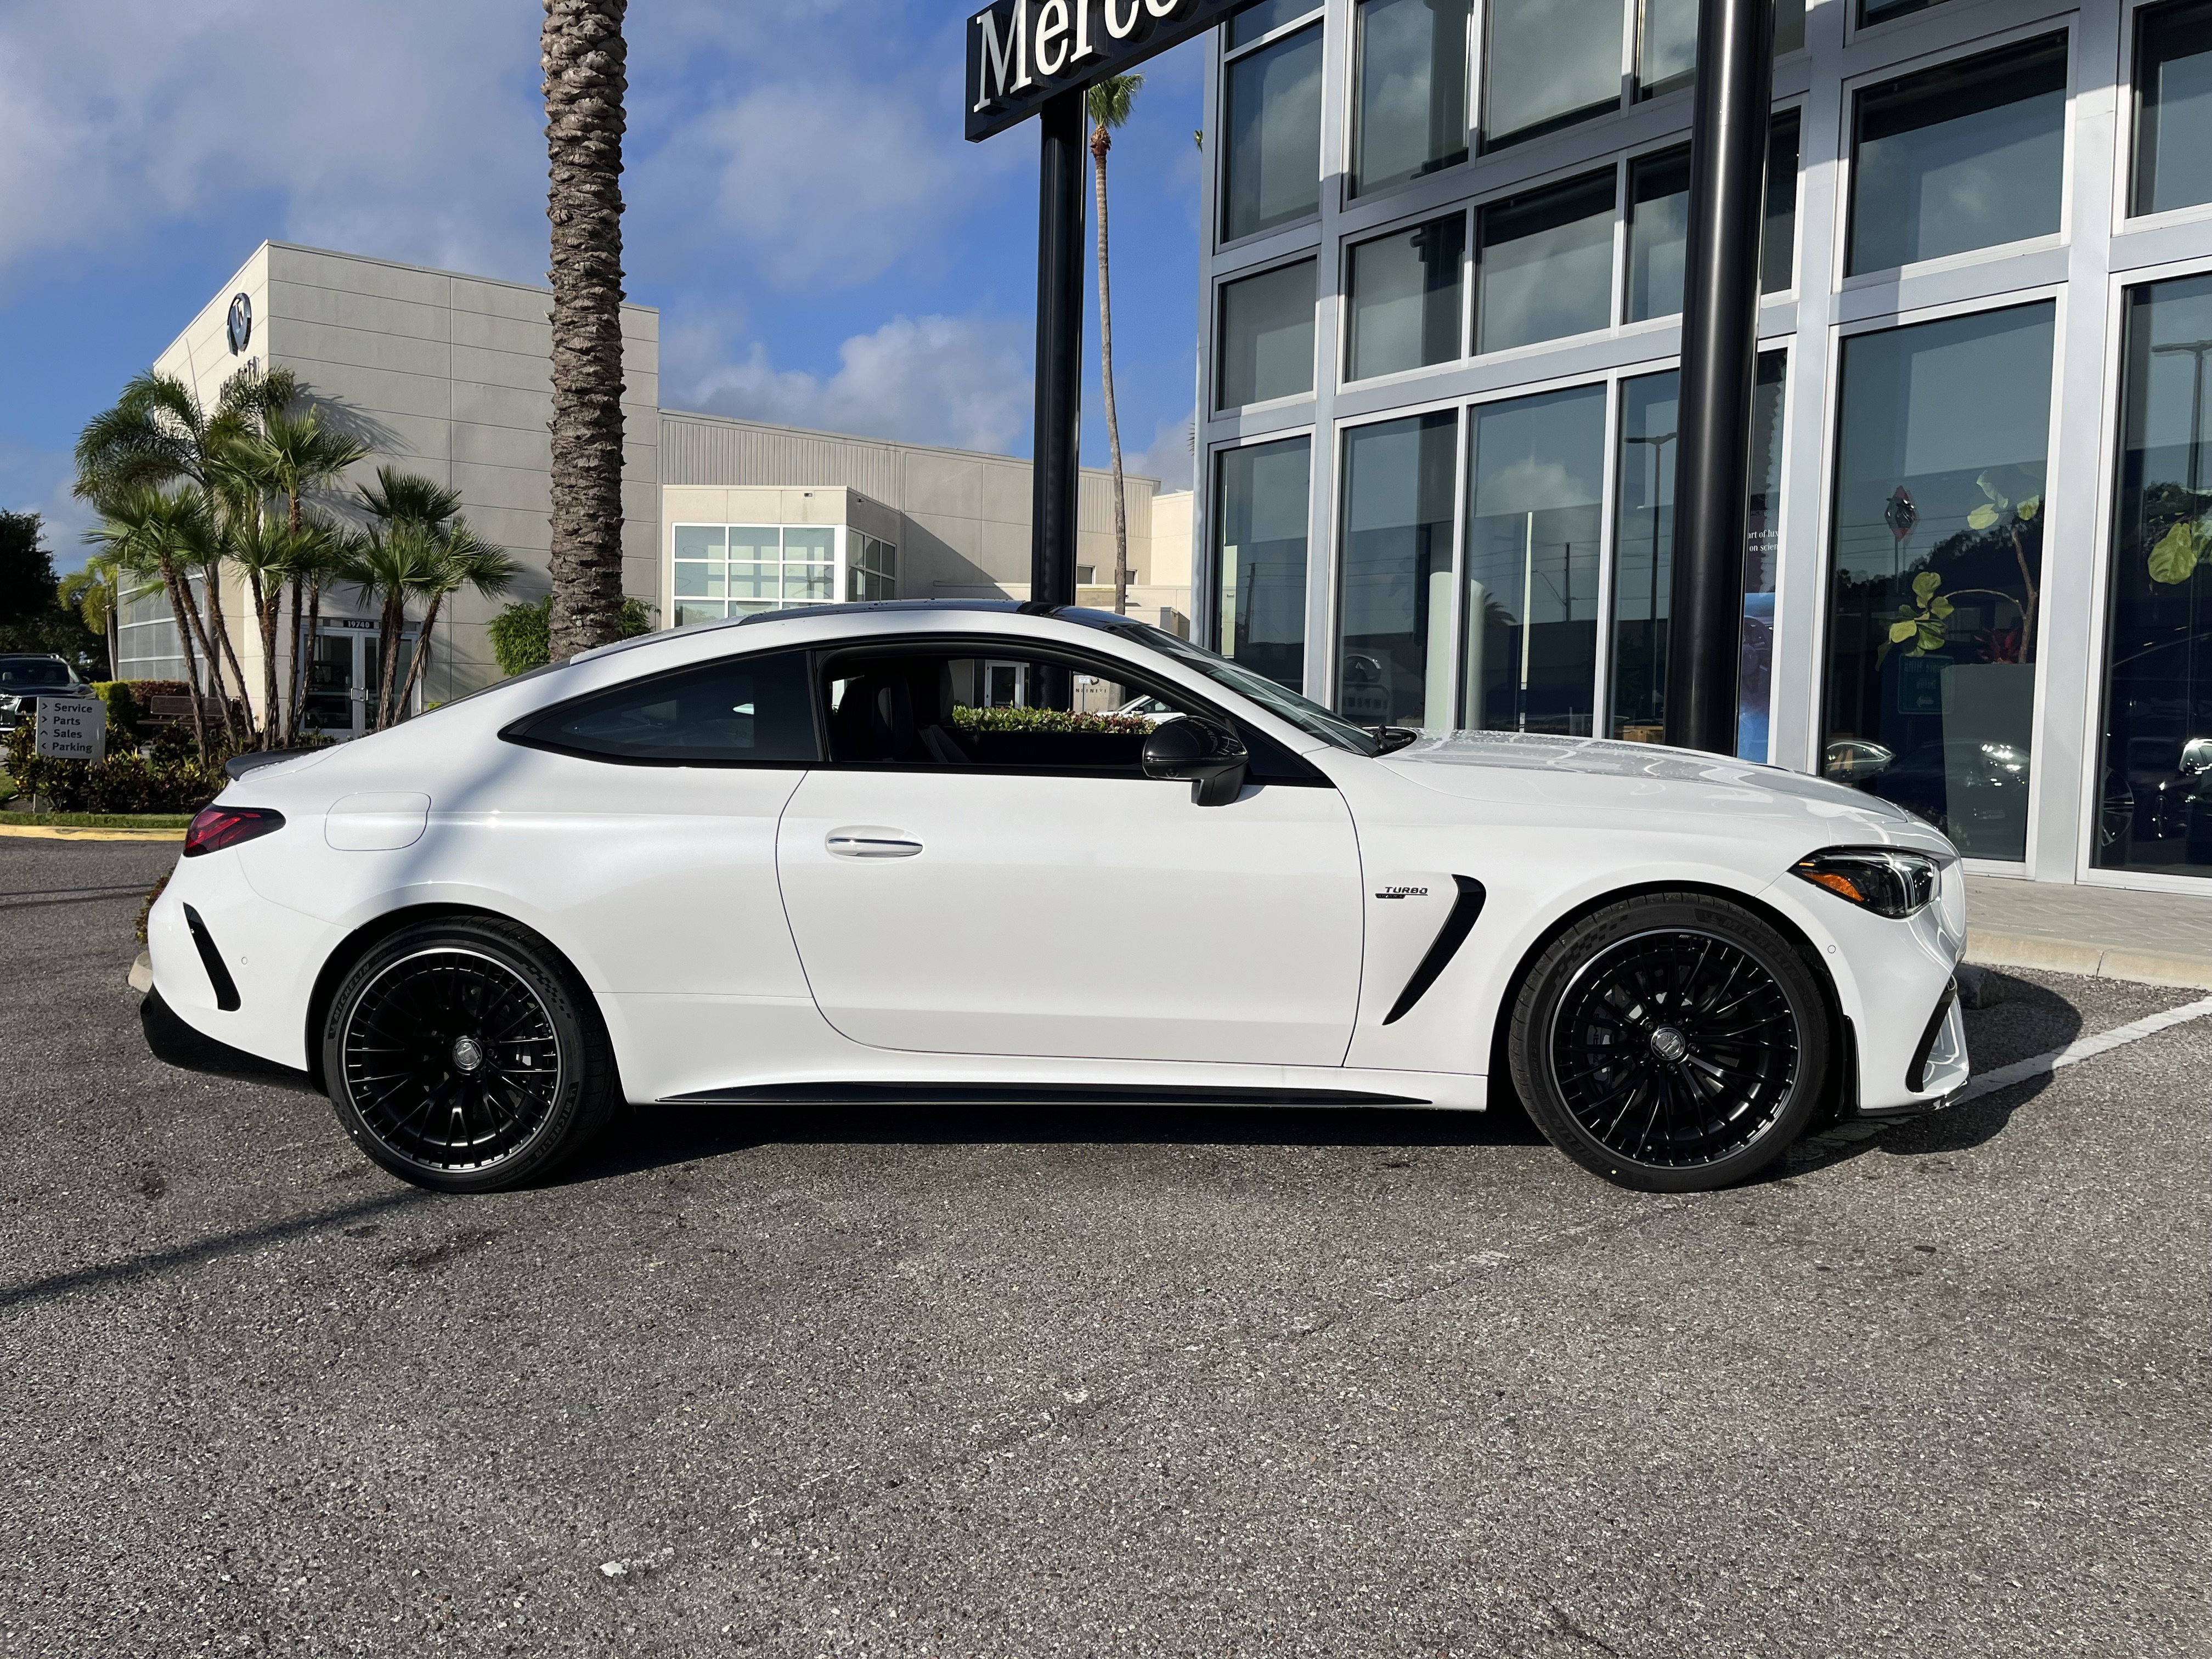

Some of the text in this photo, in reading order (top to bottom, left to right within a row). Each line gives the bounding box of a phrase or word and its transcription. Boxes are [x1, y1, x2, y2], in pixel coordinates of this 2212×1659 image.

[1759, 529, 1767, 538] of
[54, 703, 93, 713] Service
[53, 716, 81, 725] Parts
[53, 729, 82, 738] Sales
[52, 742, 93, 754] Parking
[1723, 919, 1799, 981] MICHELIN
[332, 962, 371, 1022] MICHELIN
[1531, 1054, 1542, 1085] SPORT
[1536, 1084, 1551, 1110] PILOT
[533, 1101, 573, 1159] MICHELIN
